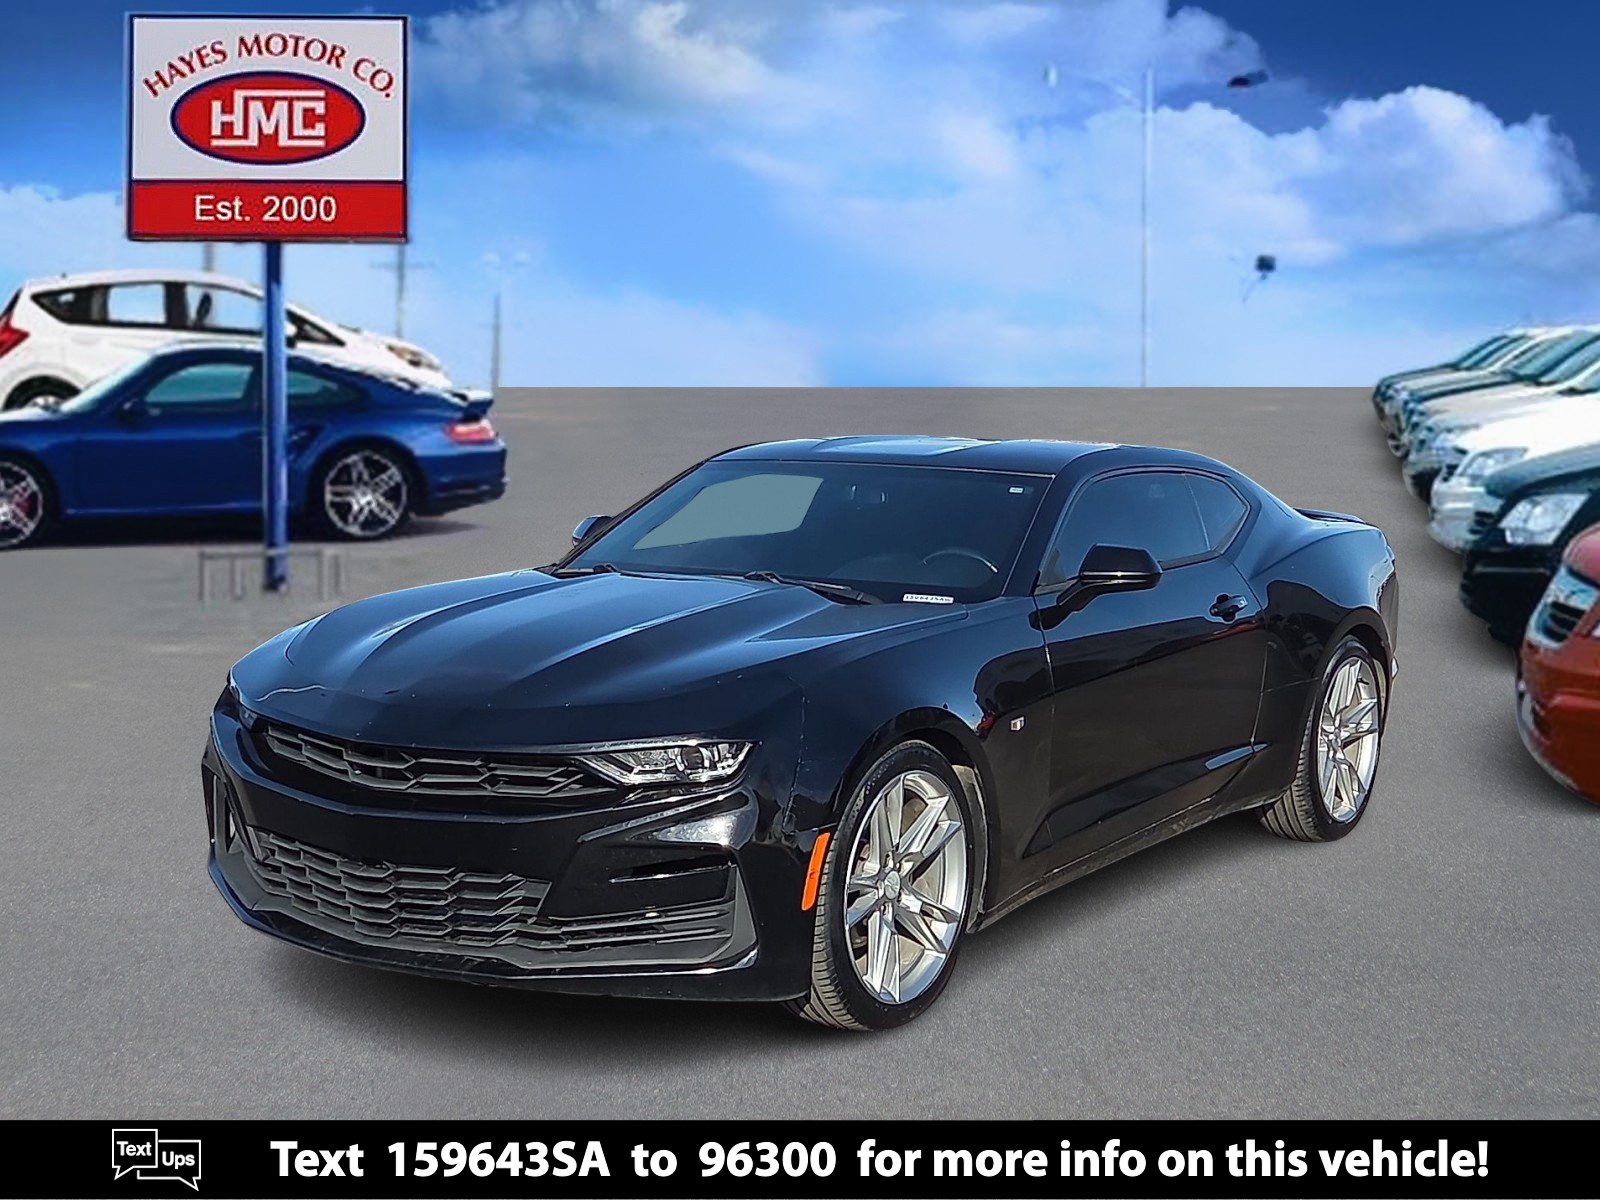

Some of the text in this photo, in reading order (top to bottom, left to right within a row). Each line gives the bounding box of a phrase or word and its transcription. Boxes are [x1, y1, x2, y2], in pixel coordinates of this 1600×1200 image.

[143, 33, 395, 98] HAYES MOTOR CO.
[210, 89, 326, 147] HMC
[195, 194, 337, 222] Est. 2000
